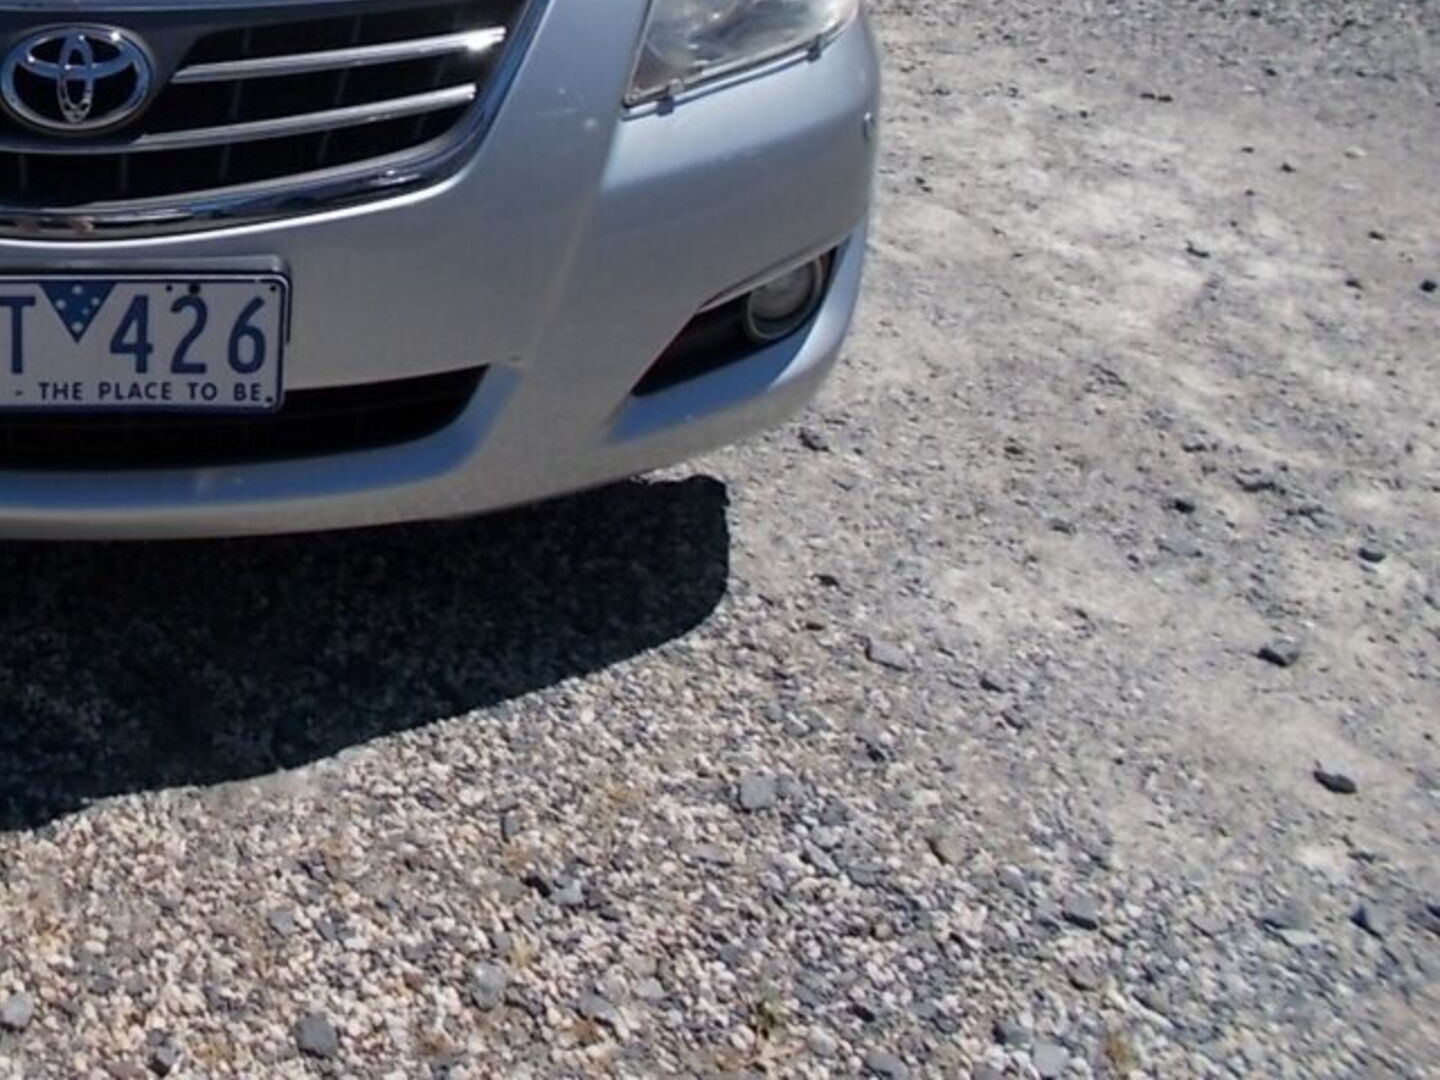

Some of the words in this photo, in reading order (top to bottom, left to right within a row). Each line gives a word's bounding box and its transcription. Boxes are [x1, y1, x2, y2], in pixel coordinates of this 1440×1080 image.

[109, 295, 266, 375] 426
[38, 382, 83, 401] THE
[98, 381, 172, 401] PLACE
[189, 381, 217, 400] TO
